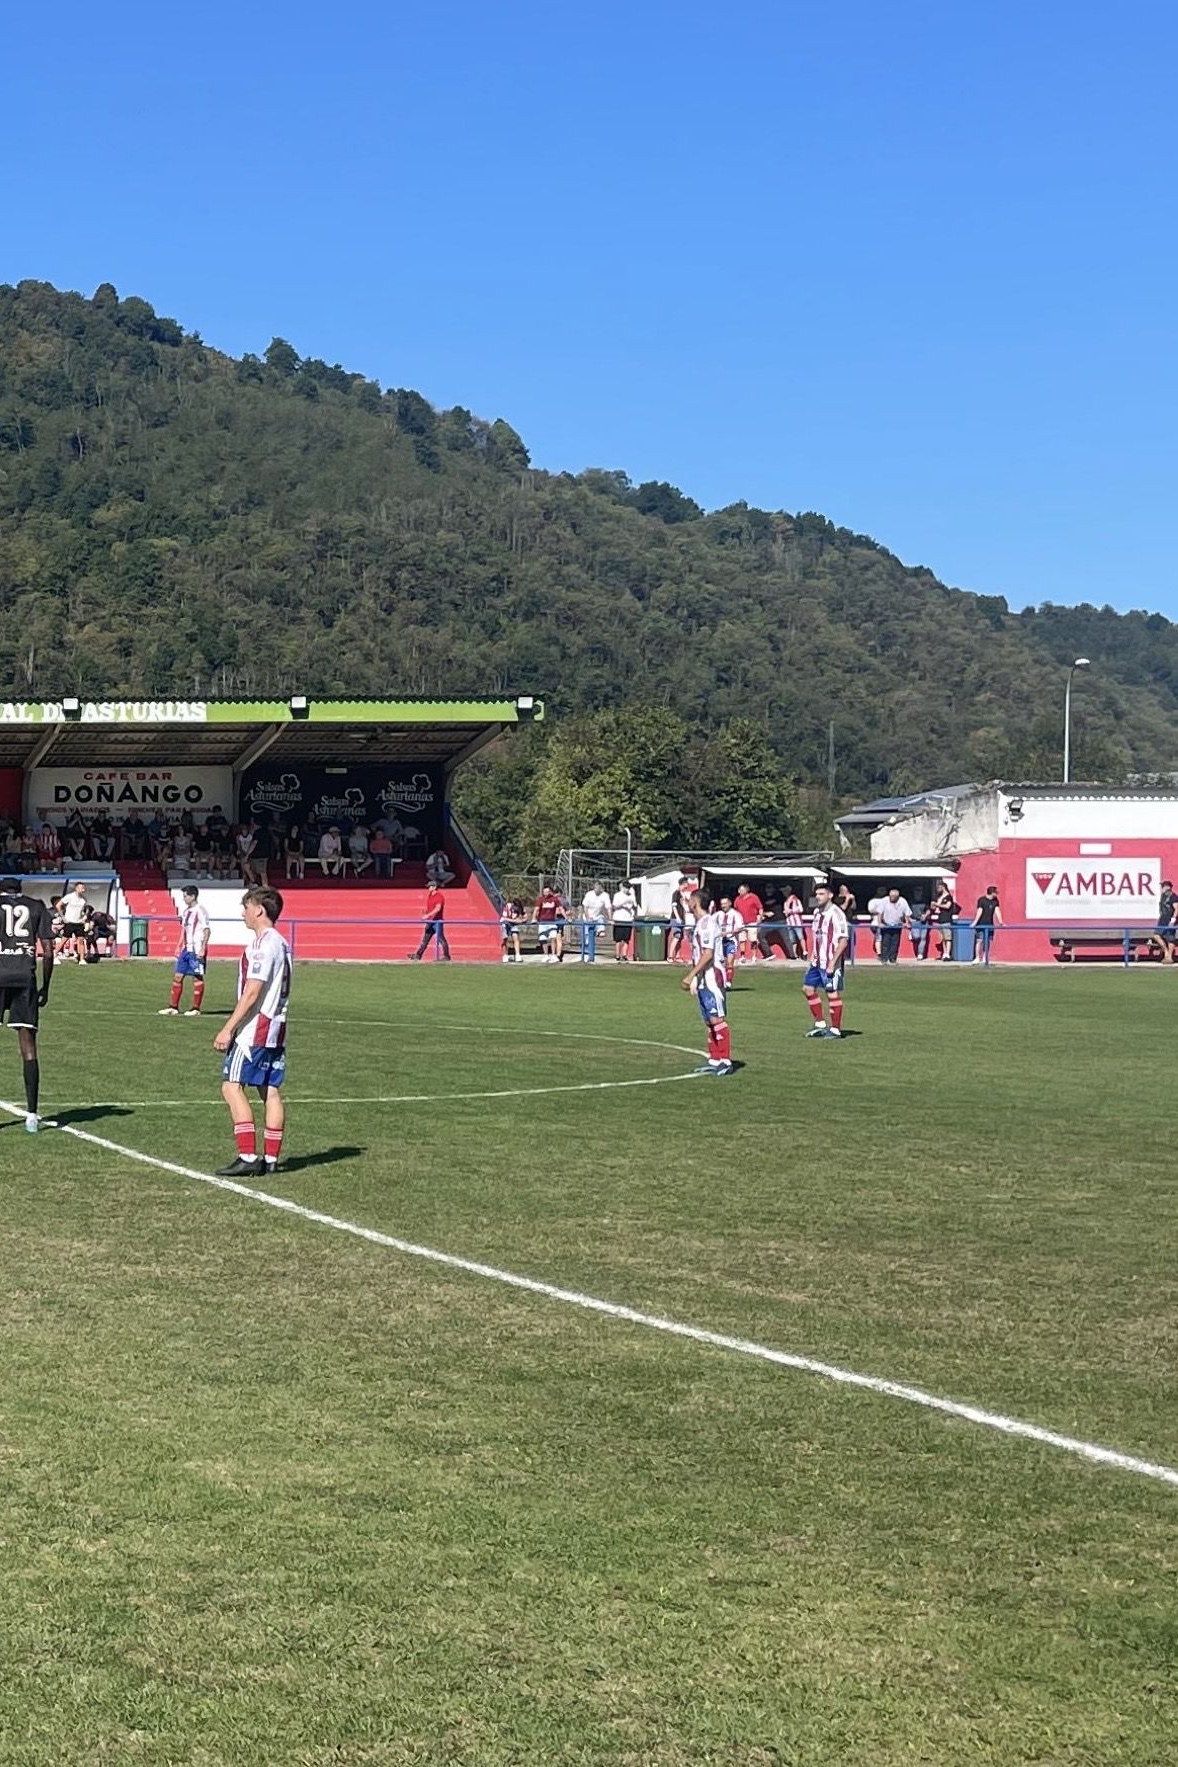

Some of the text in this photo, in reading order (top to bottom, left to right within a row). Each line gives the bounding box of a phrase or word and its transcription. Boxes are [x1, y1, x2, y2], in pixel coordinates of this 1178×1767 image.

[80, 701, 207, 723] ASTURIAS
[136, 772, 173, 781] BAR
[1055, 872, 1155, 896] AMBAR
[1, 904, 30, 937] 12
